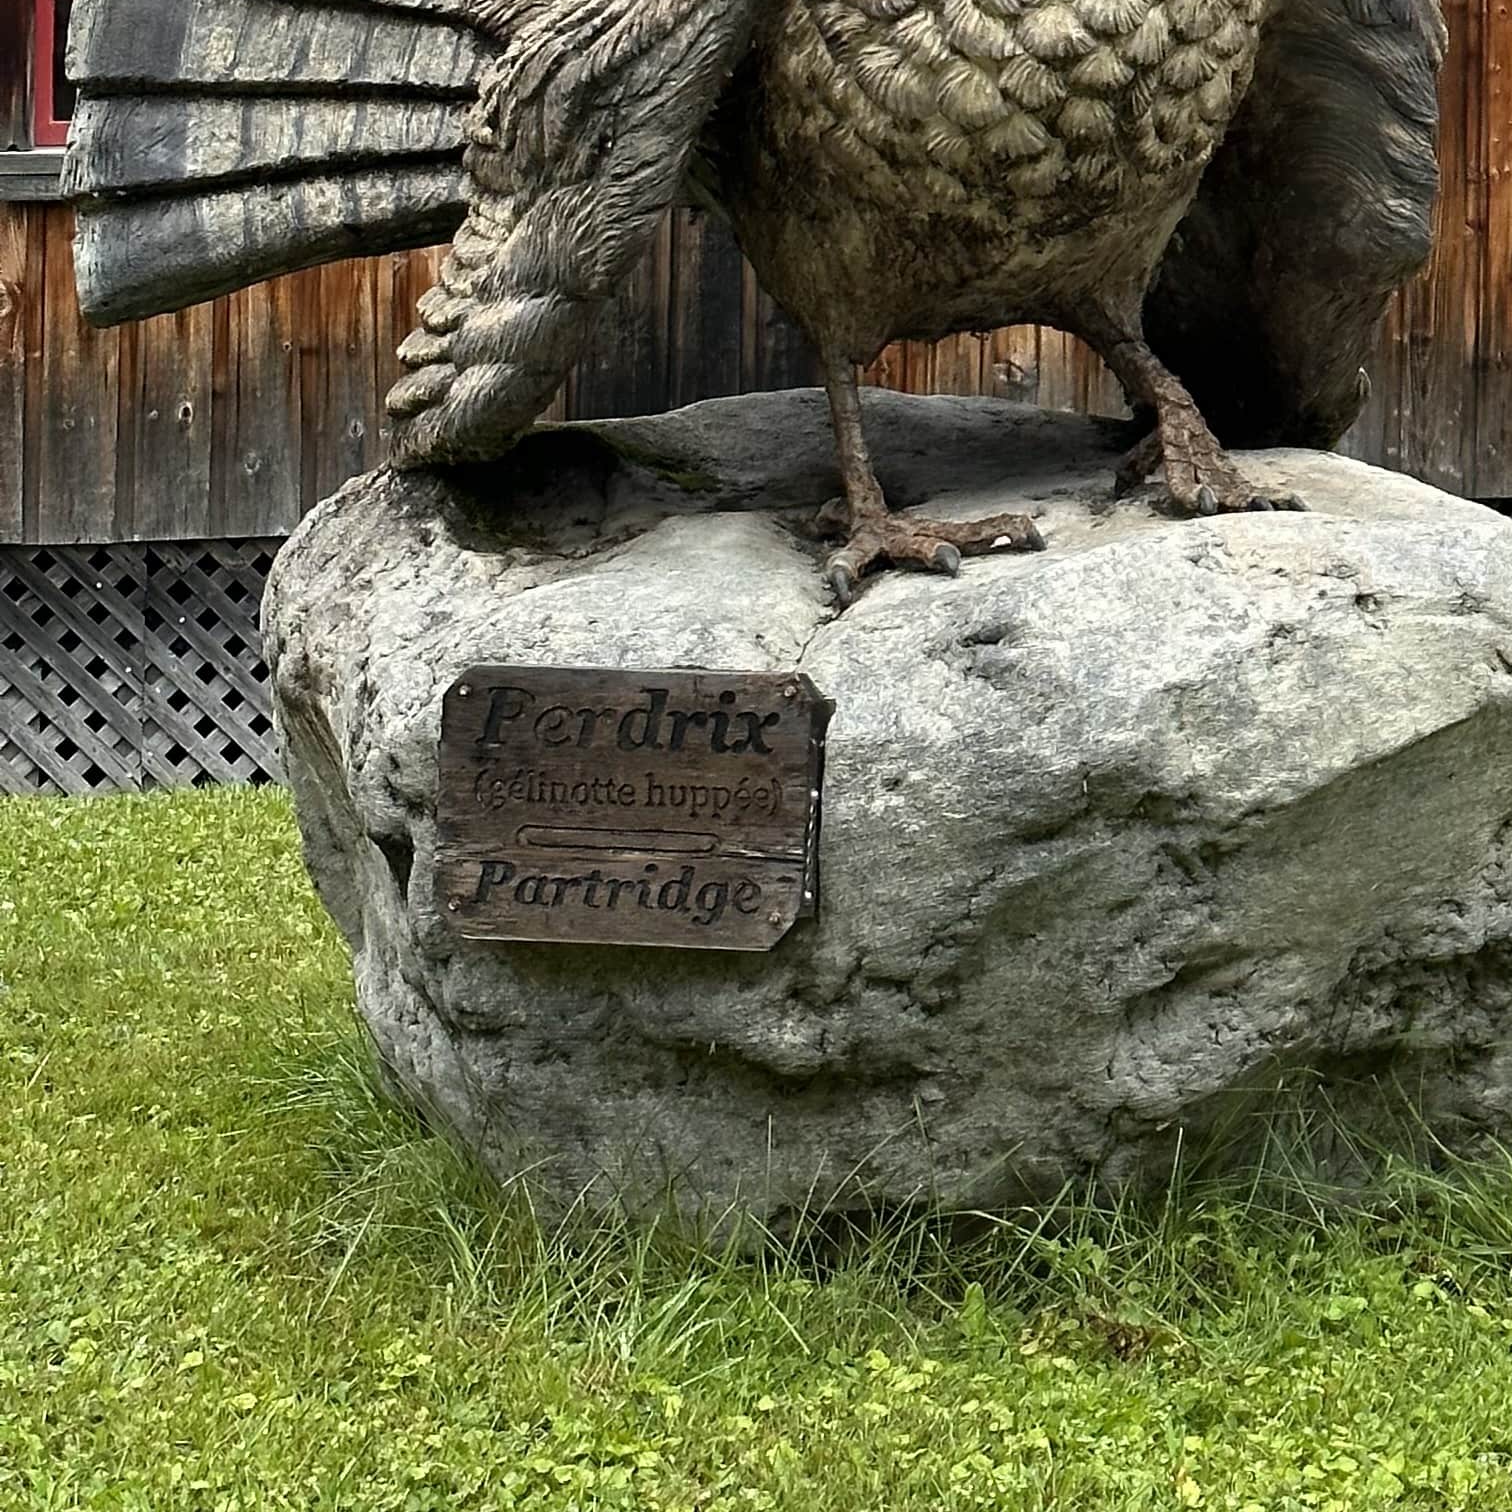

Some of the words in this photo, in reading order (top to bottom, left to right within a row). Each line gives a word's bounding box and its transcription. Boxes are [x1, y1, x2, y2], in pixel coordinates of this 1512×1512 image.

[475, 686, 781, 755] Perdrix
[474, 768, 636, 811] (gélinotte
[645, 772, 784, 818] huppée)
[470, 859, 763, 925] Partridge
